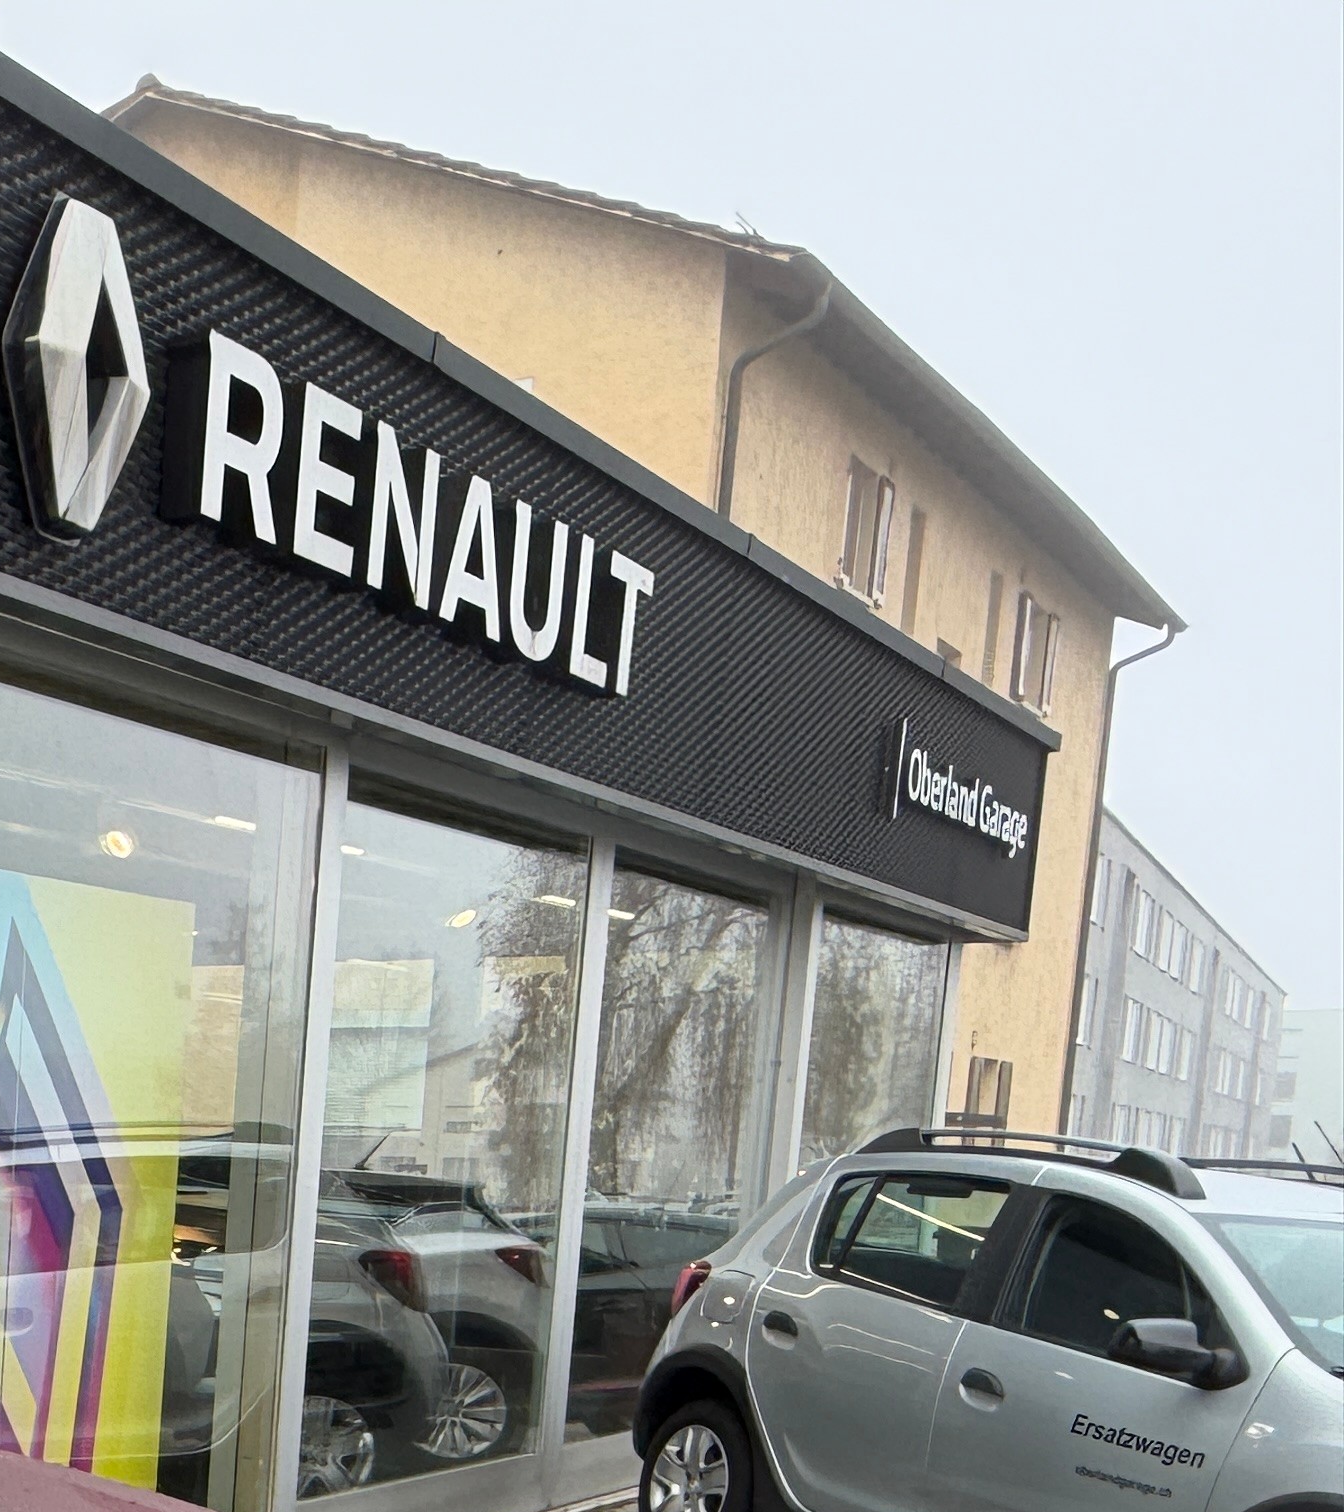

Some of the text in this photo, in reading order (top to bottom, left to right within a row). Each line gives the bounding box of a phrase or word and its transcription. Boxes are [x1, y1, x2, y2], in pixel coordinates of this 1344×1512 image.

[200, 329, 654, 698] RENAULT
[908, 748, 1028, 858] Oberland Garage
[1070, 1414, 1205, 1469] Ersatzwagen
